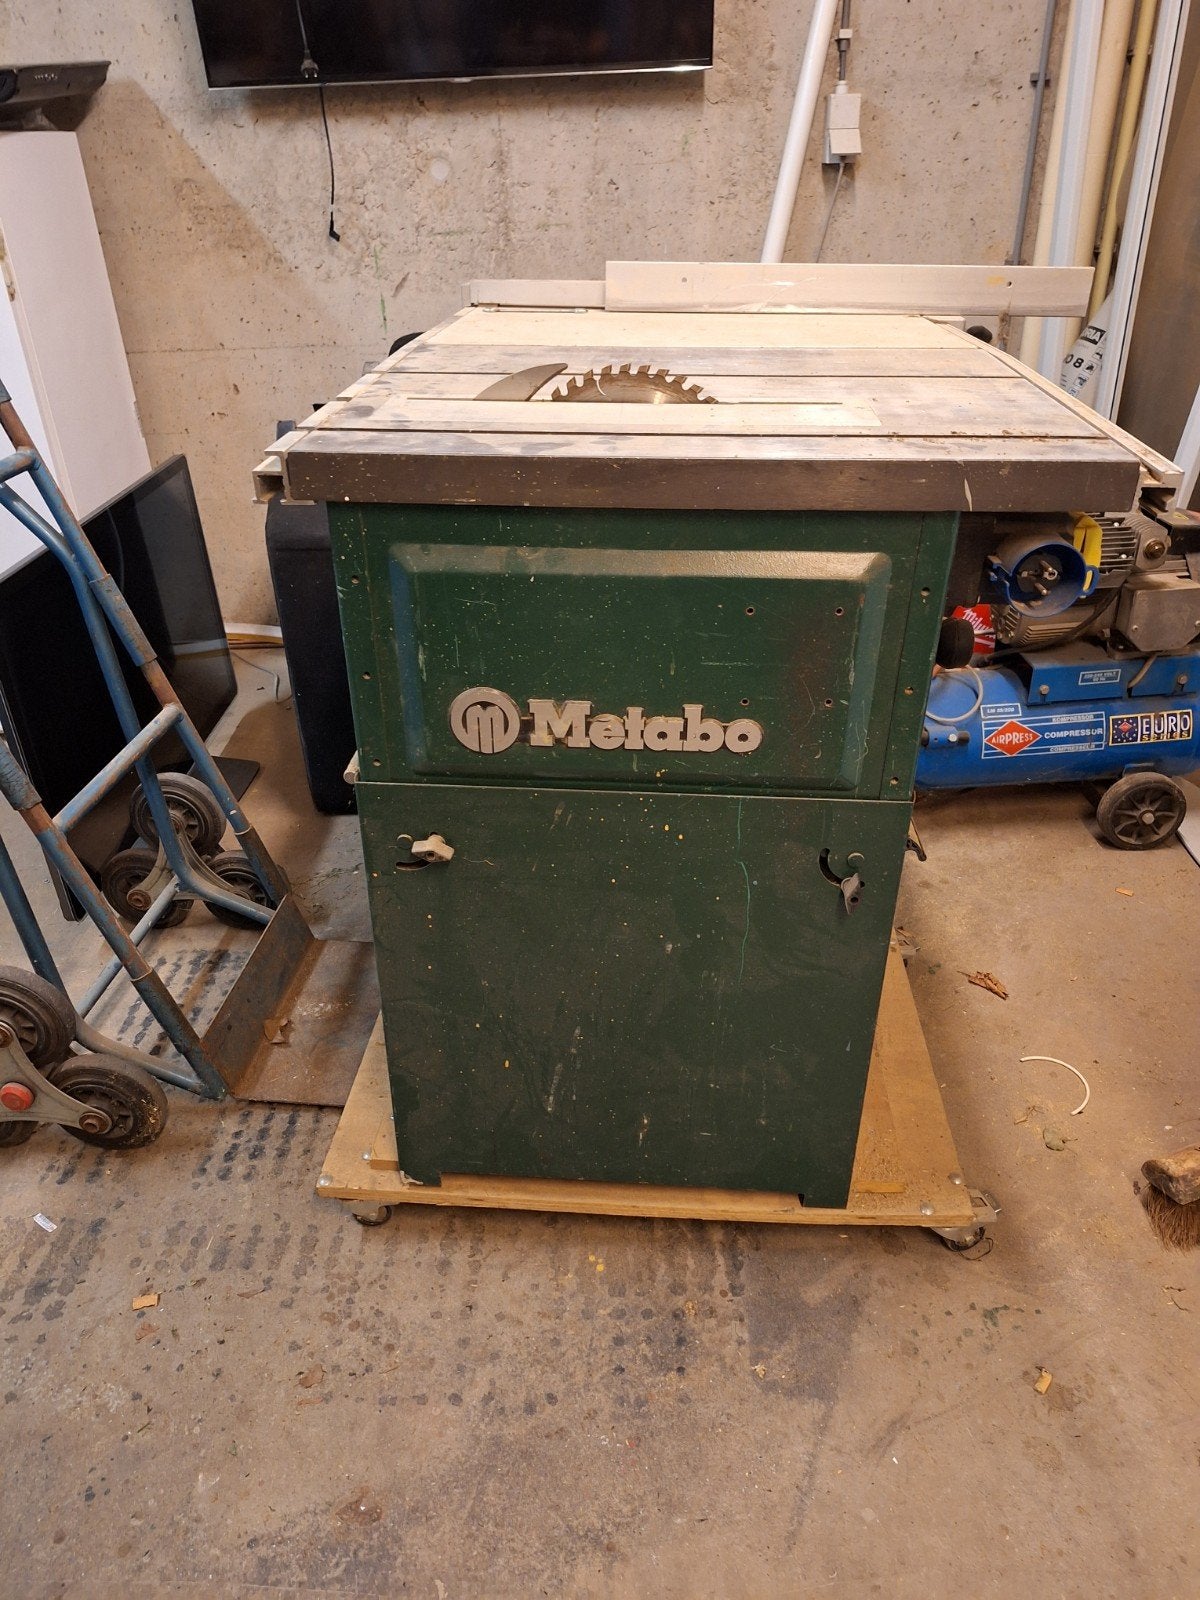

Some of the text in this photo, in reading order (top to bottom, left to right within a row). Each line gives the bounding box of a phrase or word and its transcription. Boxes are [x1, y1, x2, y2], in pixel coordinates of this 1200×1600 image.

[526, 698, 765, 753] Metabo
[1143, 714, 1190, 734] EURO
[991, 731, 1033, 745] AIRPRESS
[1044, 727, 1103, 739] COMPRESSOR
